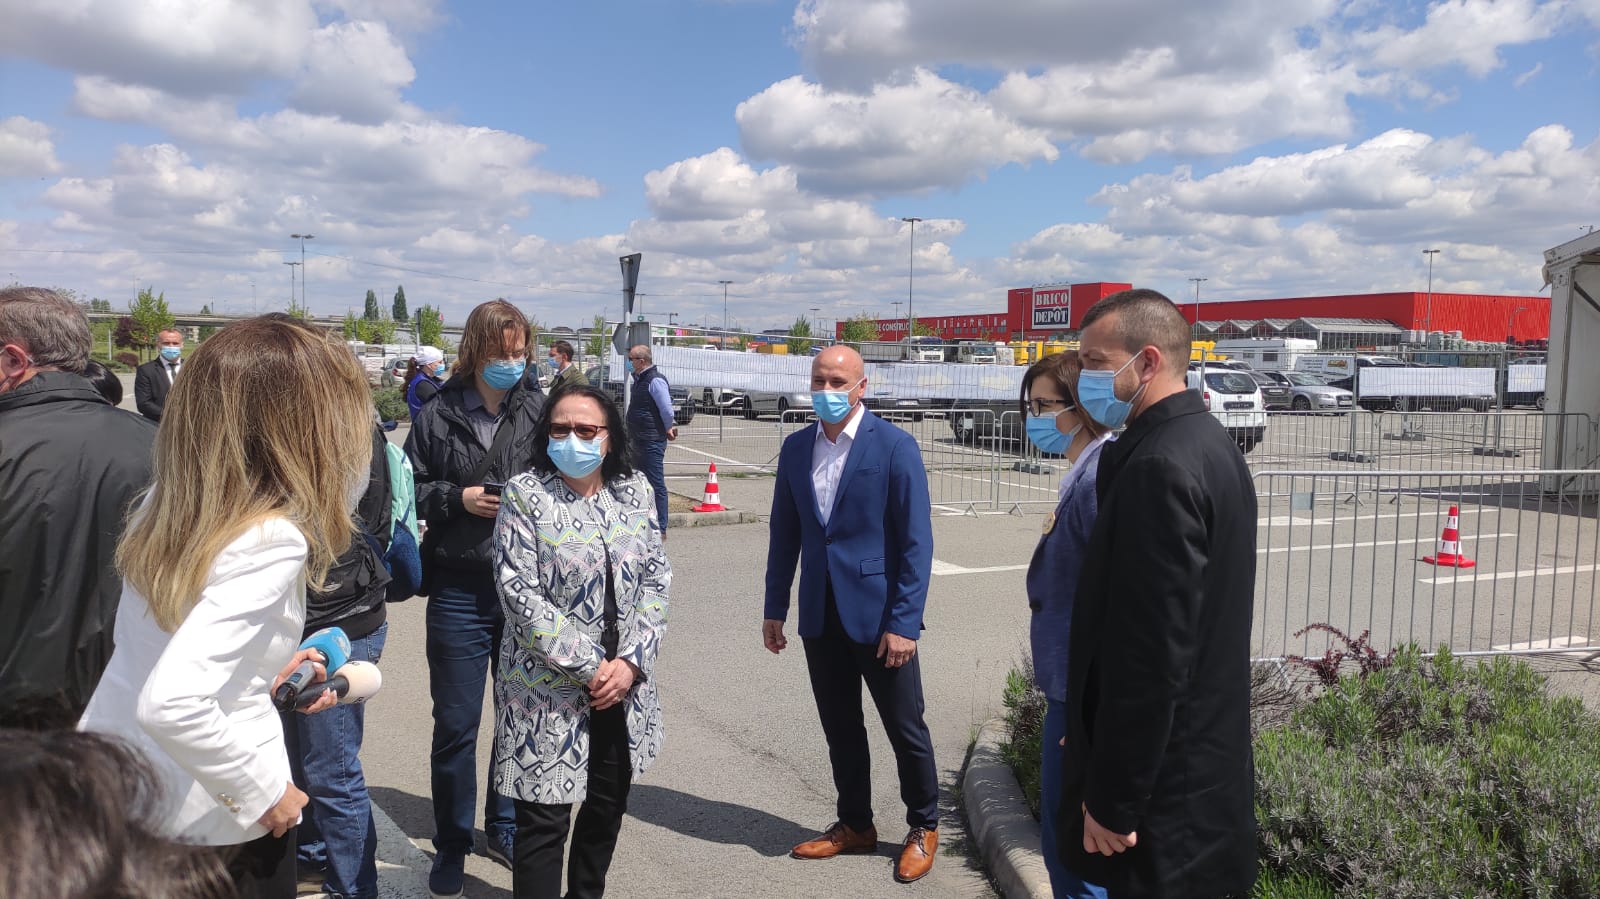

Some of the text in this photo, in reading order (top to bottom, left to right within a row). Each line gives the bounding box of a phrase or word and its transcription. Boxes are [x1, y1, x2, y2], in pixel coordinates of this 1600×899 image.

[1036, 293, 1068, 306] BRICO
[1035, 306, 1067, 323] DEPÔT
[882, 322, 910, 332] CONSTRUC
